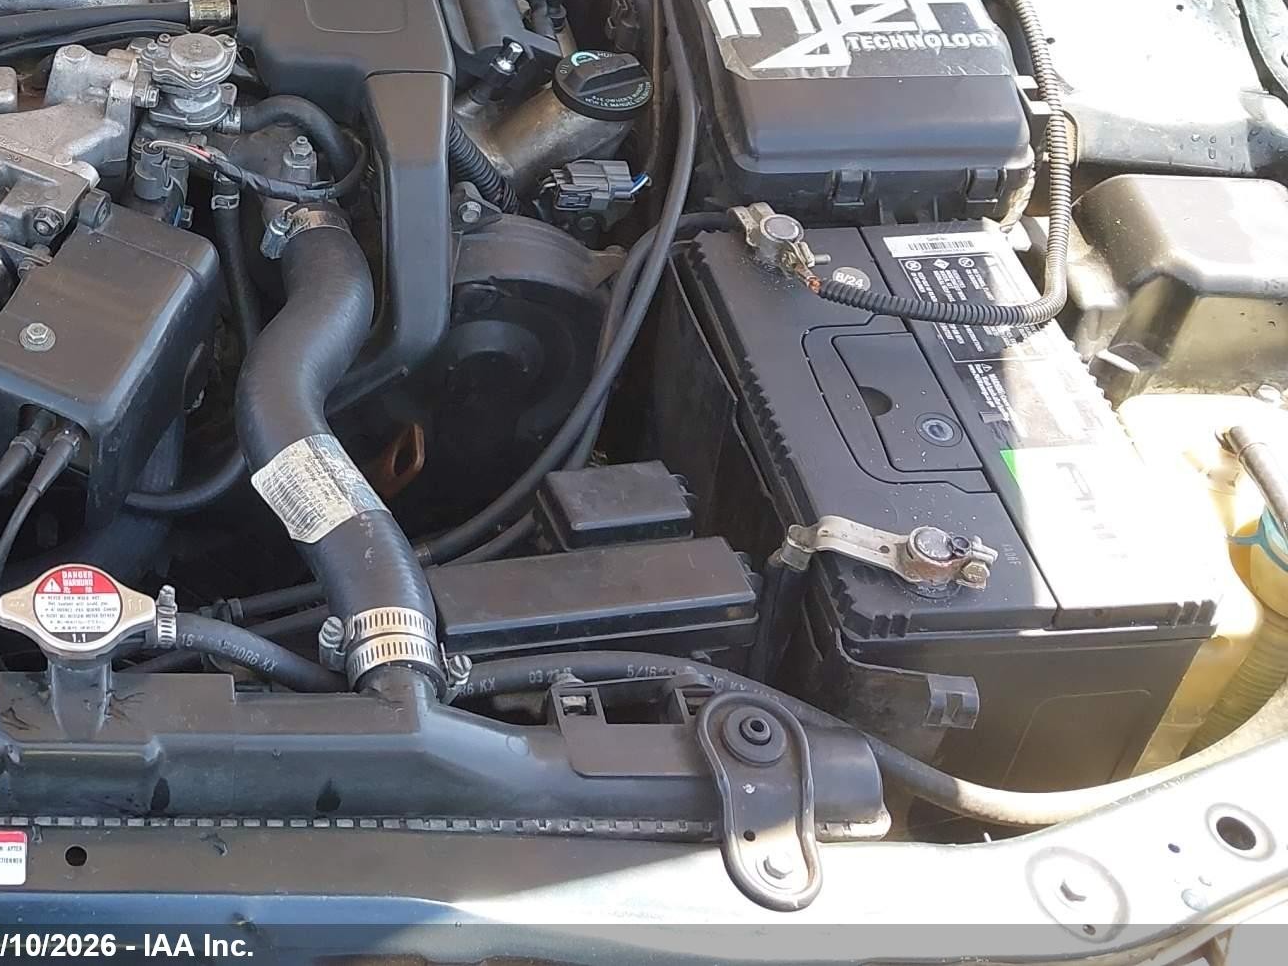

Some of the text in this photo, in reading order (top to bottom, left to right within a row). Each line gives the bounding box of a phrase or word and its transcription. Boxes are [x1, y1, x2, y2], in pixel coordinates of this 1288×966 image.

[847, 33, 999, 51] TECHNOLOGY
[835, 272, 864, 288] 8/24
[72, 634, 86, 642] 1.1
